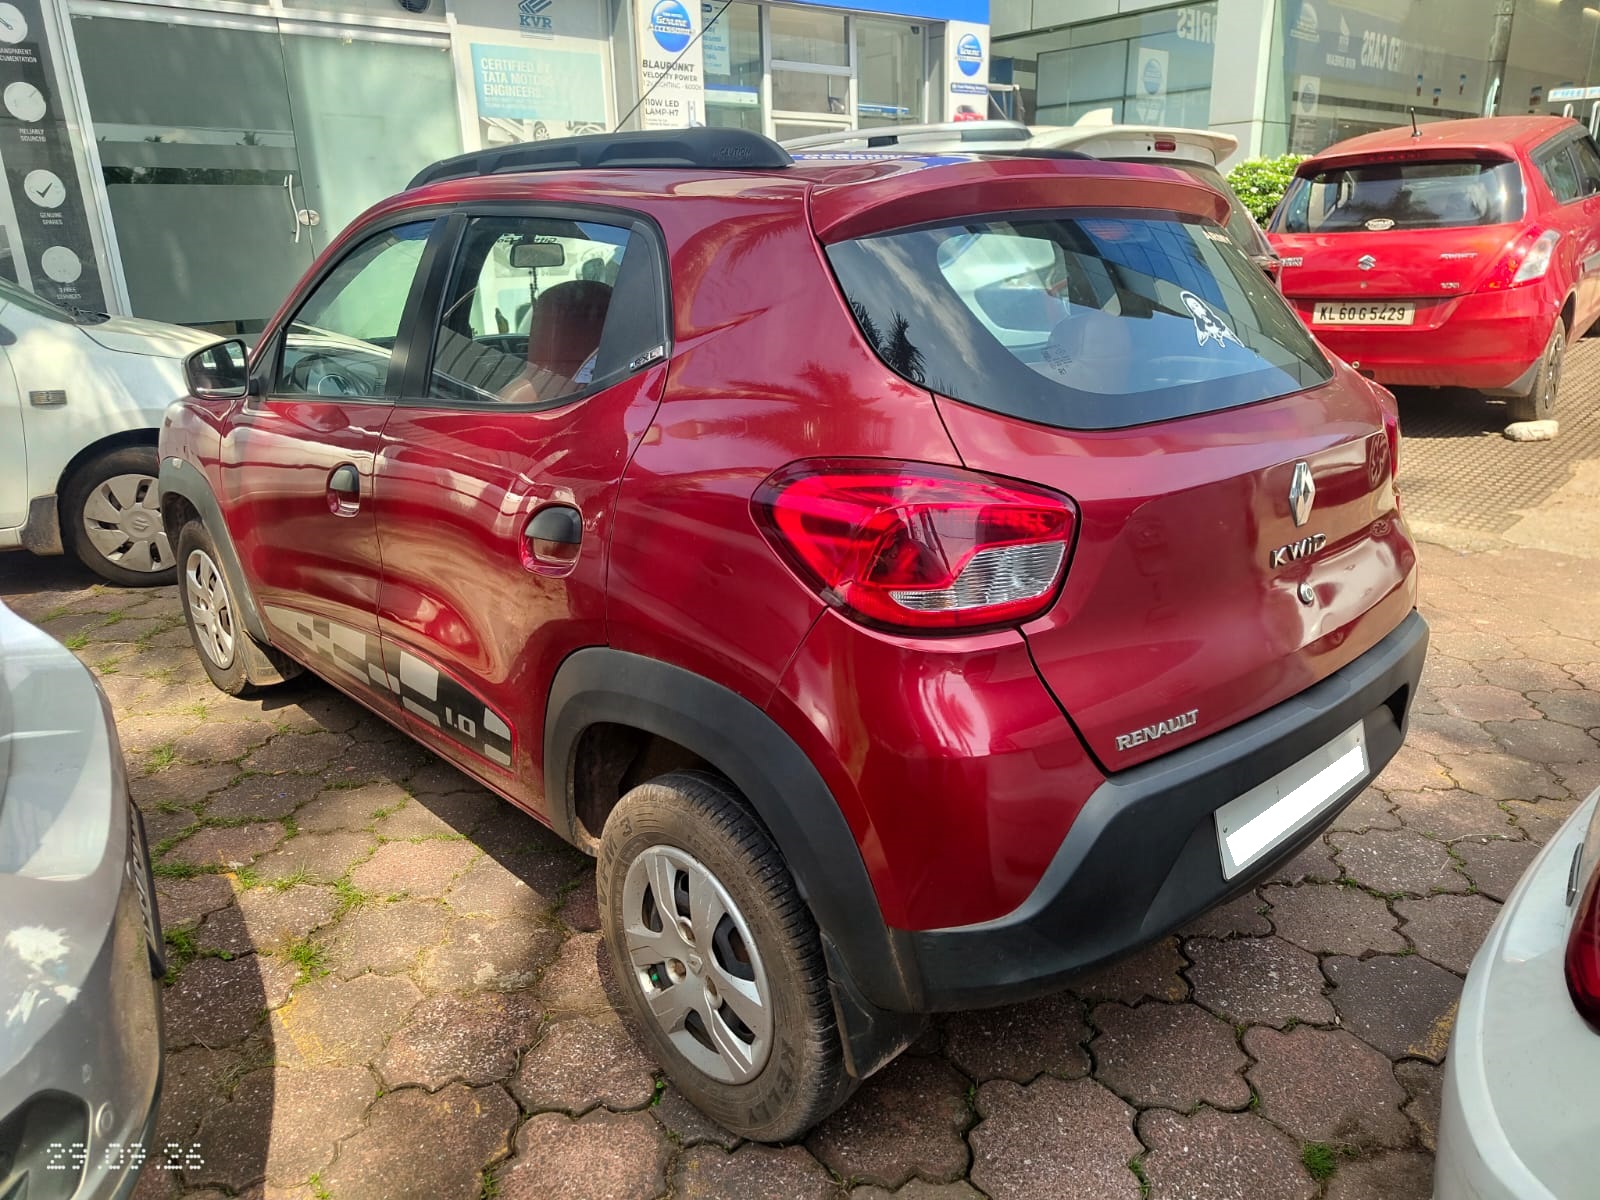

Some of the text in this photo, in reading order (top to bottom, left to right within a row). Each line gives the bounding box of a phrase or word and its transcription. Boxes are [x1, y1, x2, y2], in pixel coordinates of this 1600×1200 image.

[520, 15, 552, 28] KVR
[481, 57, 535, 73] CERTIFIED
[642, 59, 695, 73] BLAUPUNKT
[482, 70, 508, 83] TATA
[643, 71, 698, 82] VELOCITY POWER
[664, 100, 680, 108] LED
[645, 108, 679, 117] LAMP-H7
[1319, 306, 1336, 321] KL
[1339, 306, 1356, 321] 60
[1370, 307, 1406, 321] 5429
[445, 706, 476, 738] 1.0
[1115, 708, 1199, 751] RENAULT
